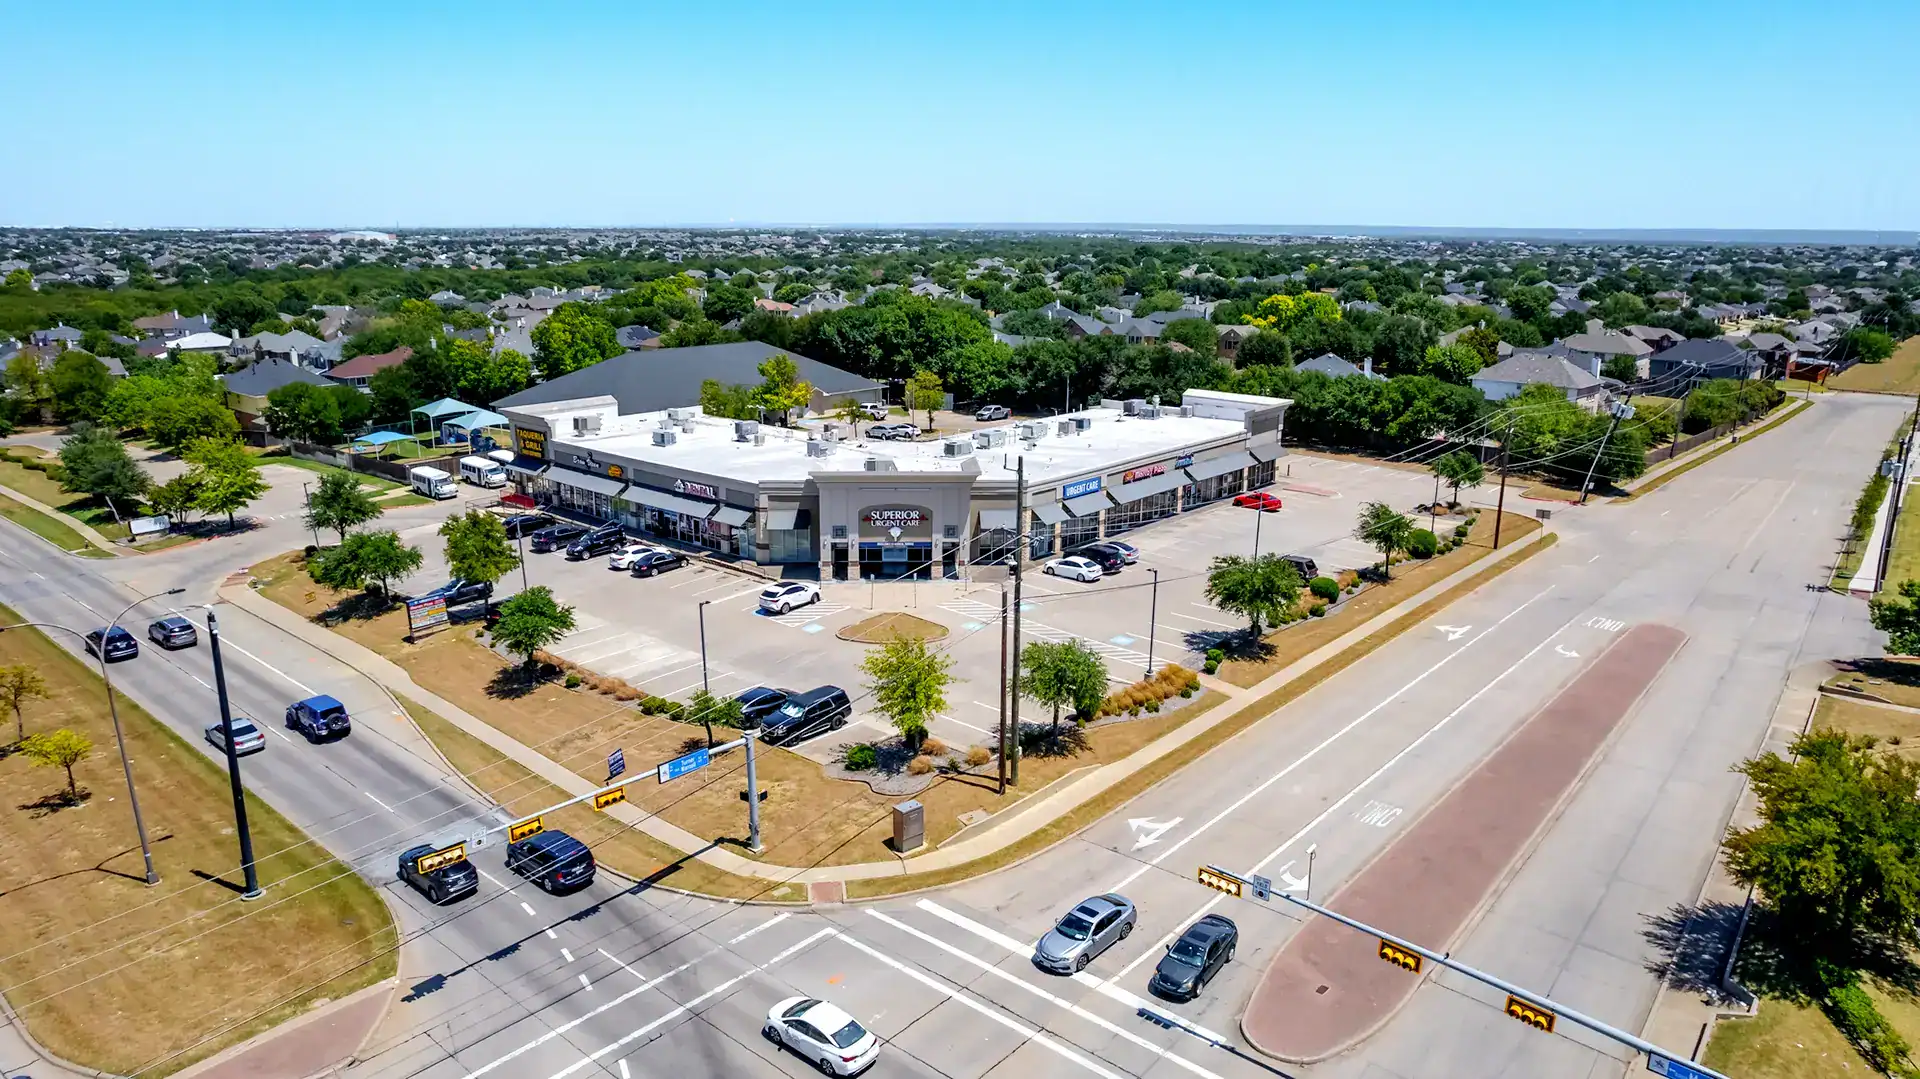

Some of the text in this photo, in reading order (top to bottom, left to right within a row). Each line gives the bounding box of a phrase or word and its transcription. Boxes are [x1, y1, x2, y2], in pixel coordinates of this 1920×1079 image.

[516, 428, 545, 441] TAQUERIA
[525, 441, 543, 451] GRILL
[684, 481, 716, 499] DENTAL
[1066, 480, 1099, 497] URGENT CARE
[870, 510, 920, 520] SUPERIOR
[870, 519, 920, 527] URGENT CARE
[1581, 616, 1625, 632] ONLY
